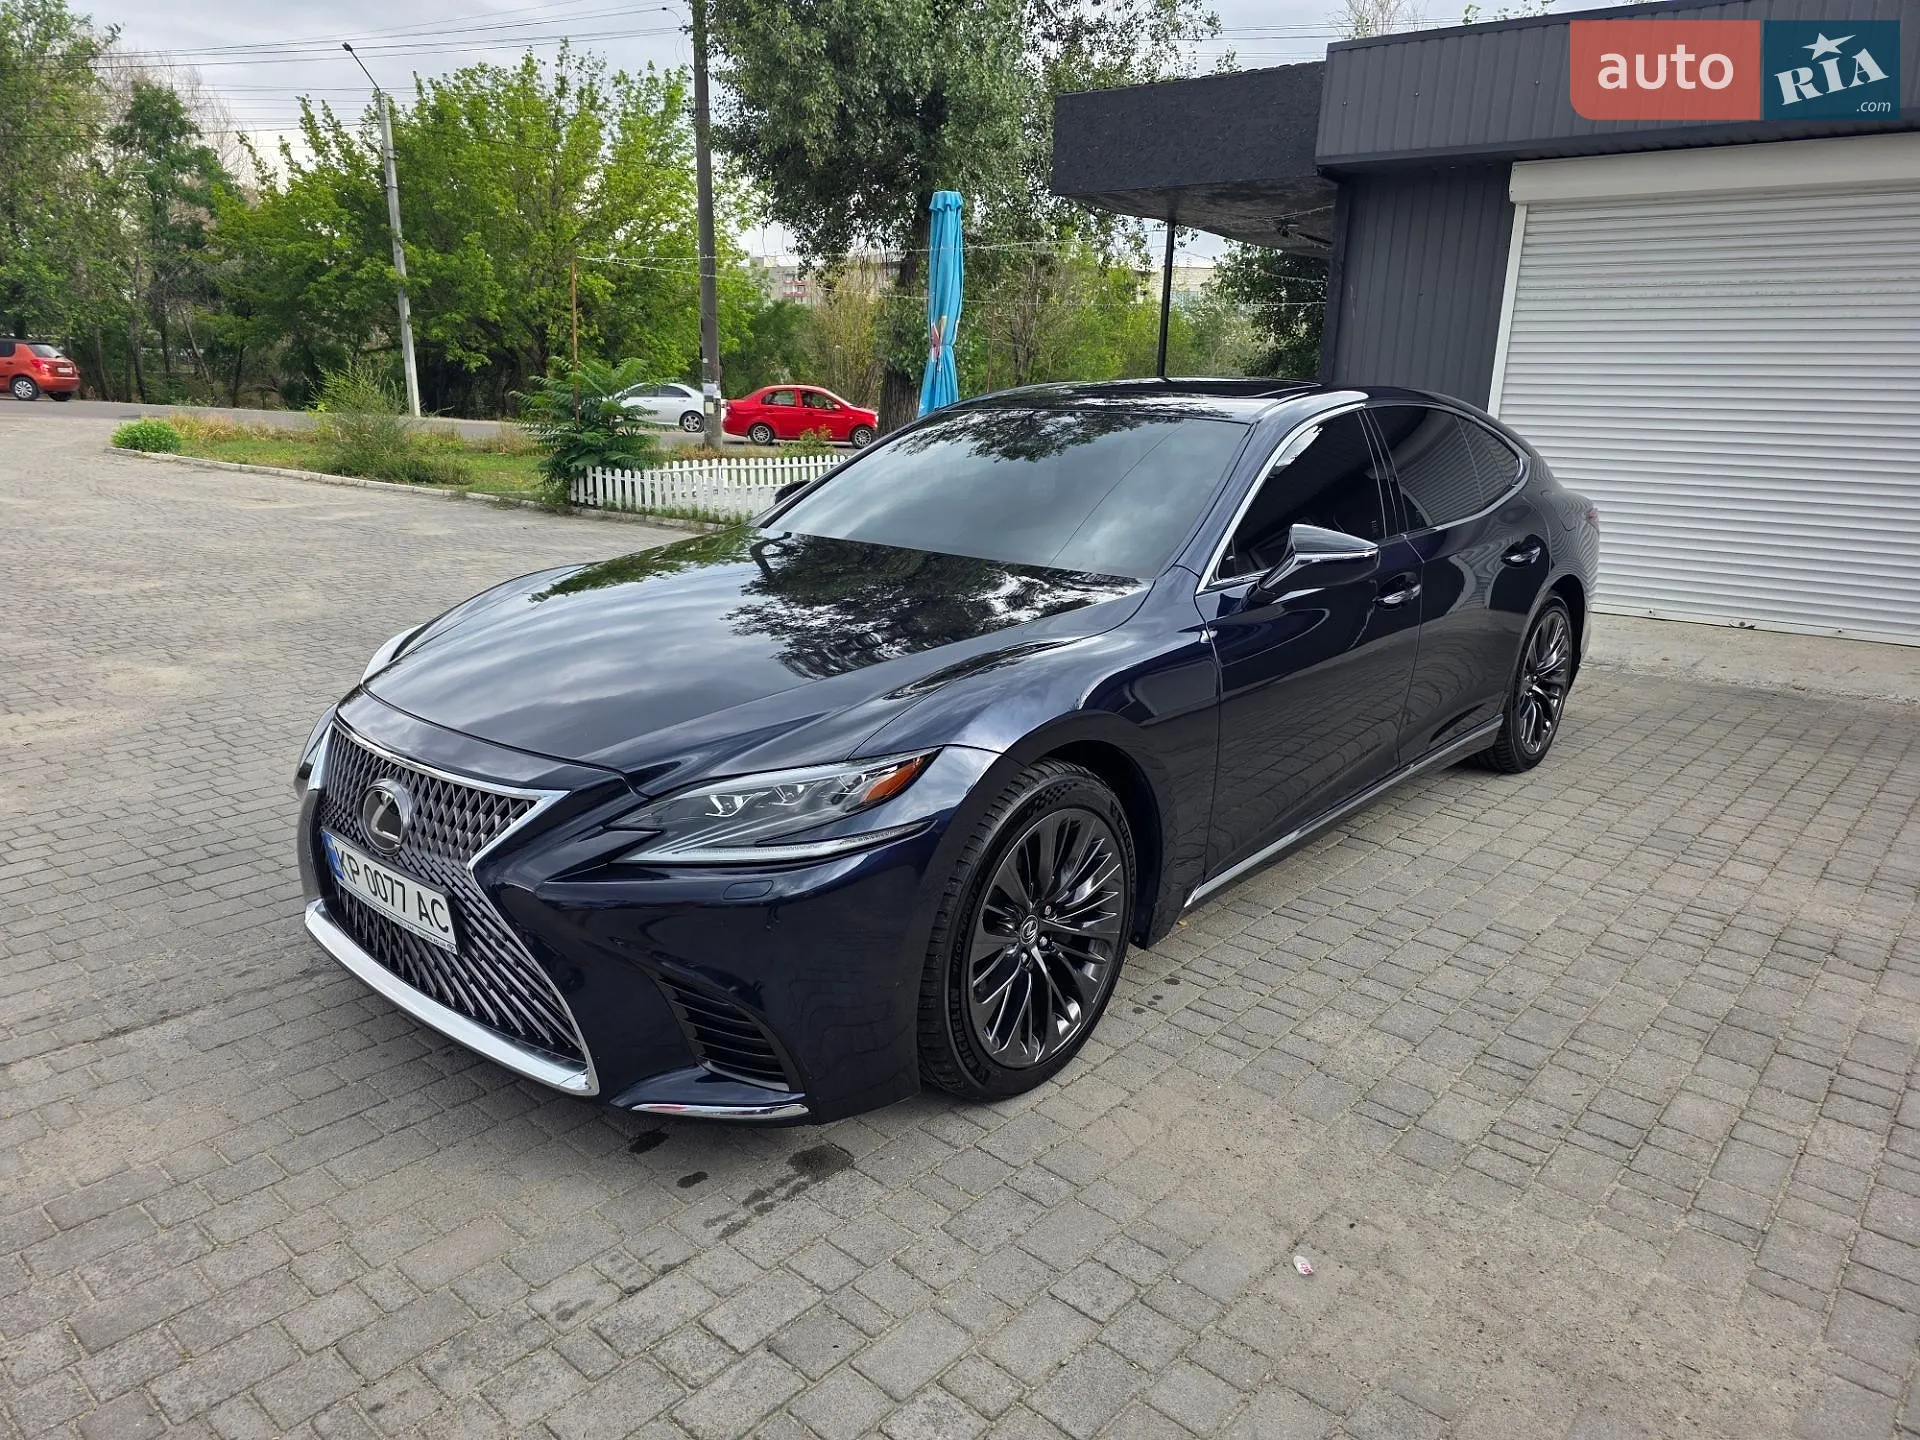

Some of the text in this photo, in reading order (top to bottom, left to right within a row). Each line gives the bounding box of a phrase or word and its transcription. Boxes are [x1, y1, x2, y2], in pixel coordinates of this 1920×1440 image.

[334, 845, 360, 885] KP
[363, 863, 406, 913] 0077
[416, 890, 449, 933] AC
